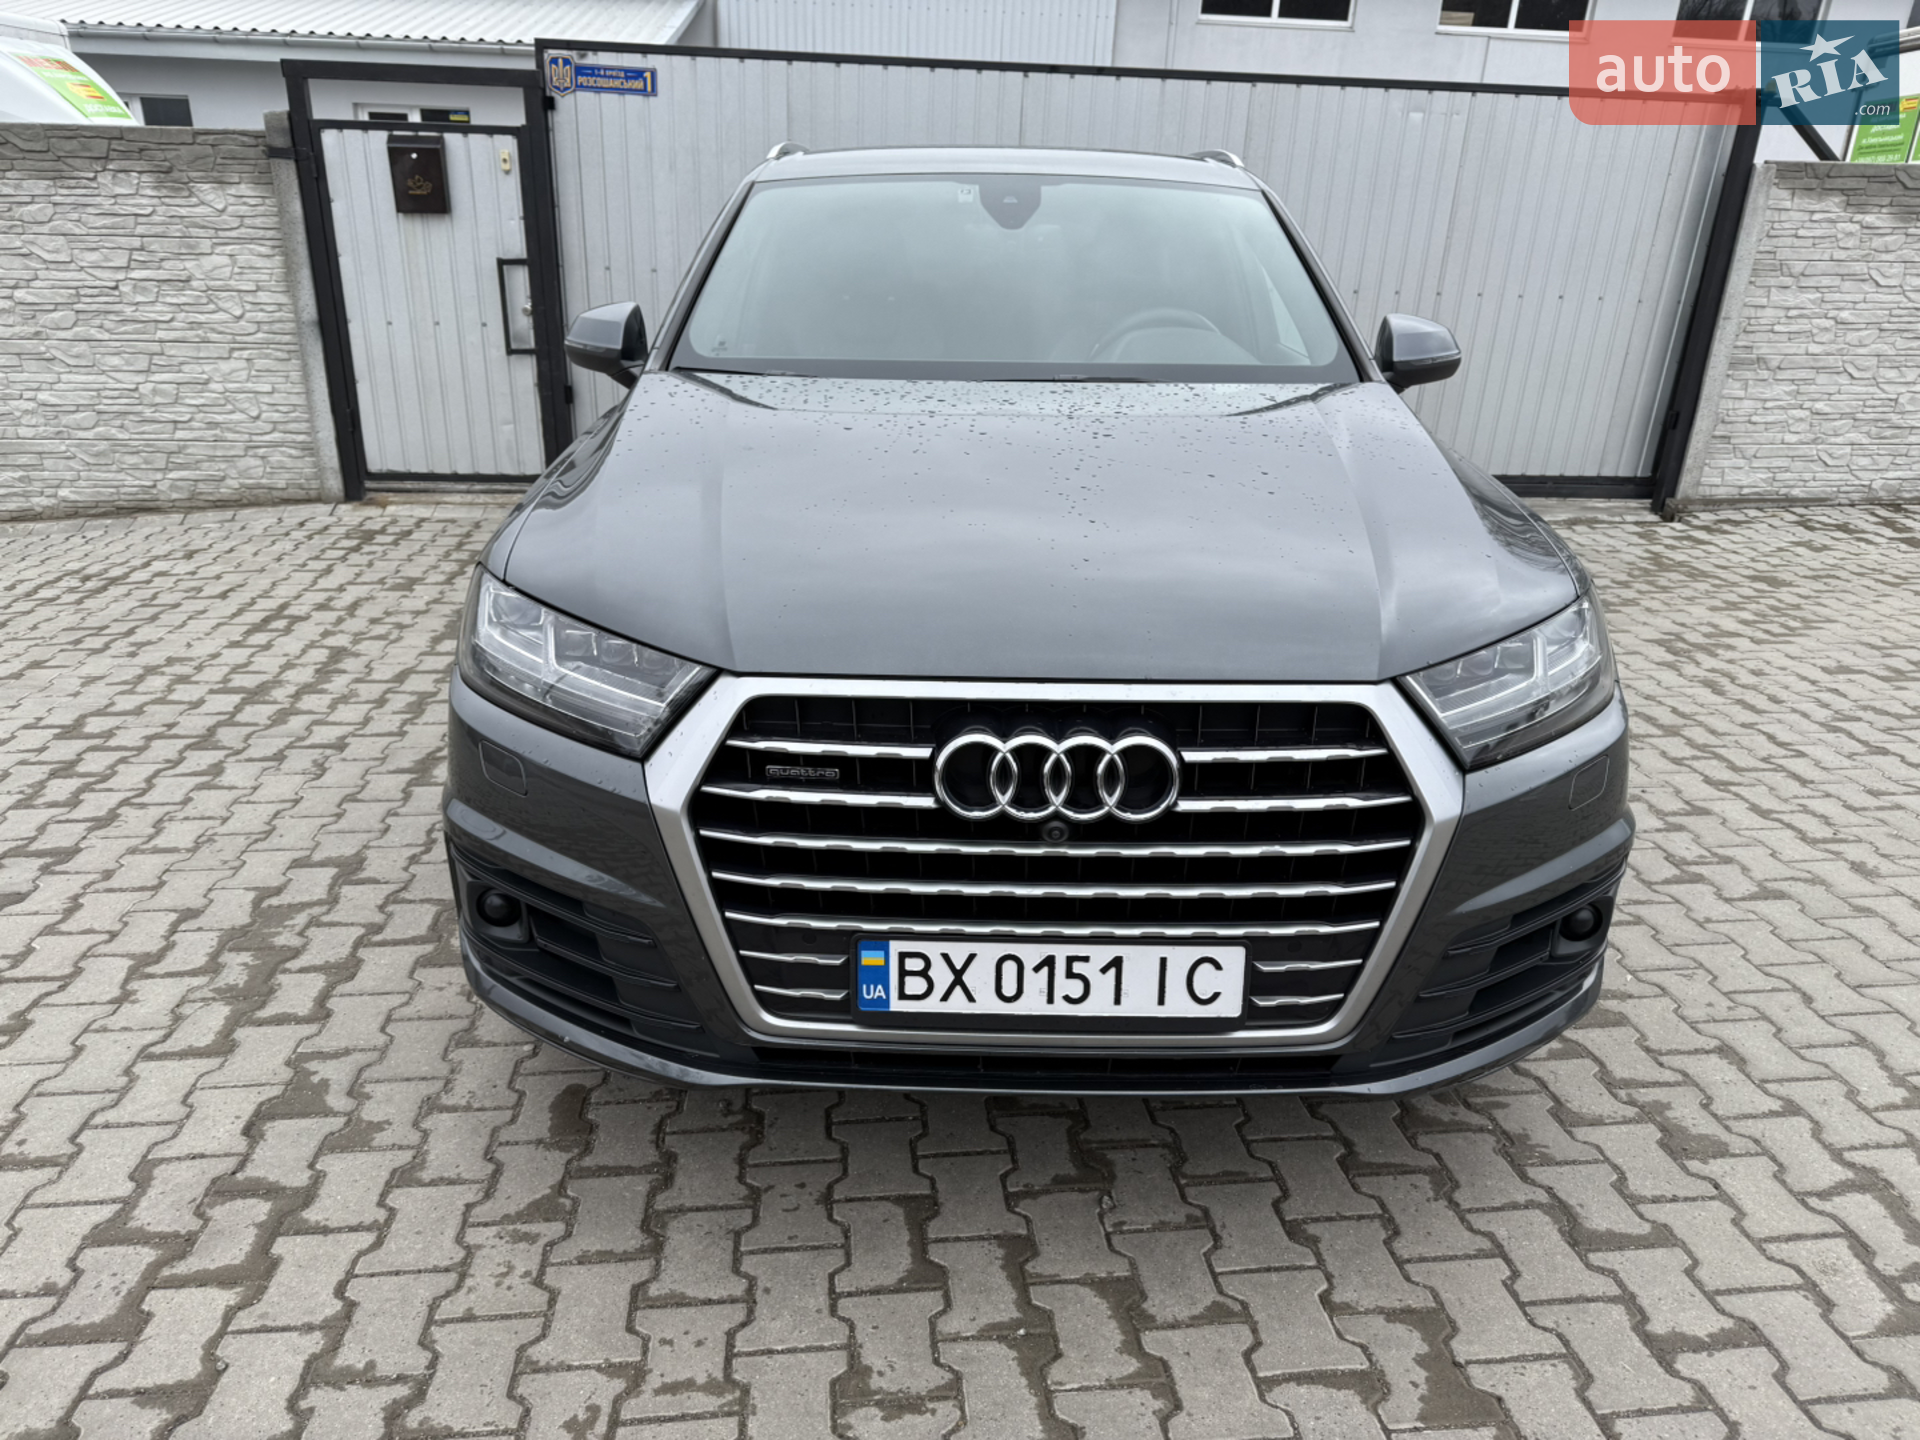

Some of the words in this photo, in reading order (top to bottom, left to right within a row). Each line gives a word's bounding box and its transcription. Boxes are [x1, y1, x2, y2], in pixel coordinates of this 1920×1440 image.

[643, 71, 651, 93] 1
[769, 768, 835, 777] quattro
[897, 951, 978, 1003] BX
[994, 953, 1124, 1006] 0151
[1157, 955, 1224, 1006] IC
[862, 984, 886, 999] UA
